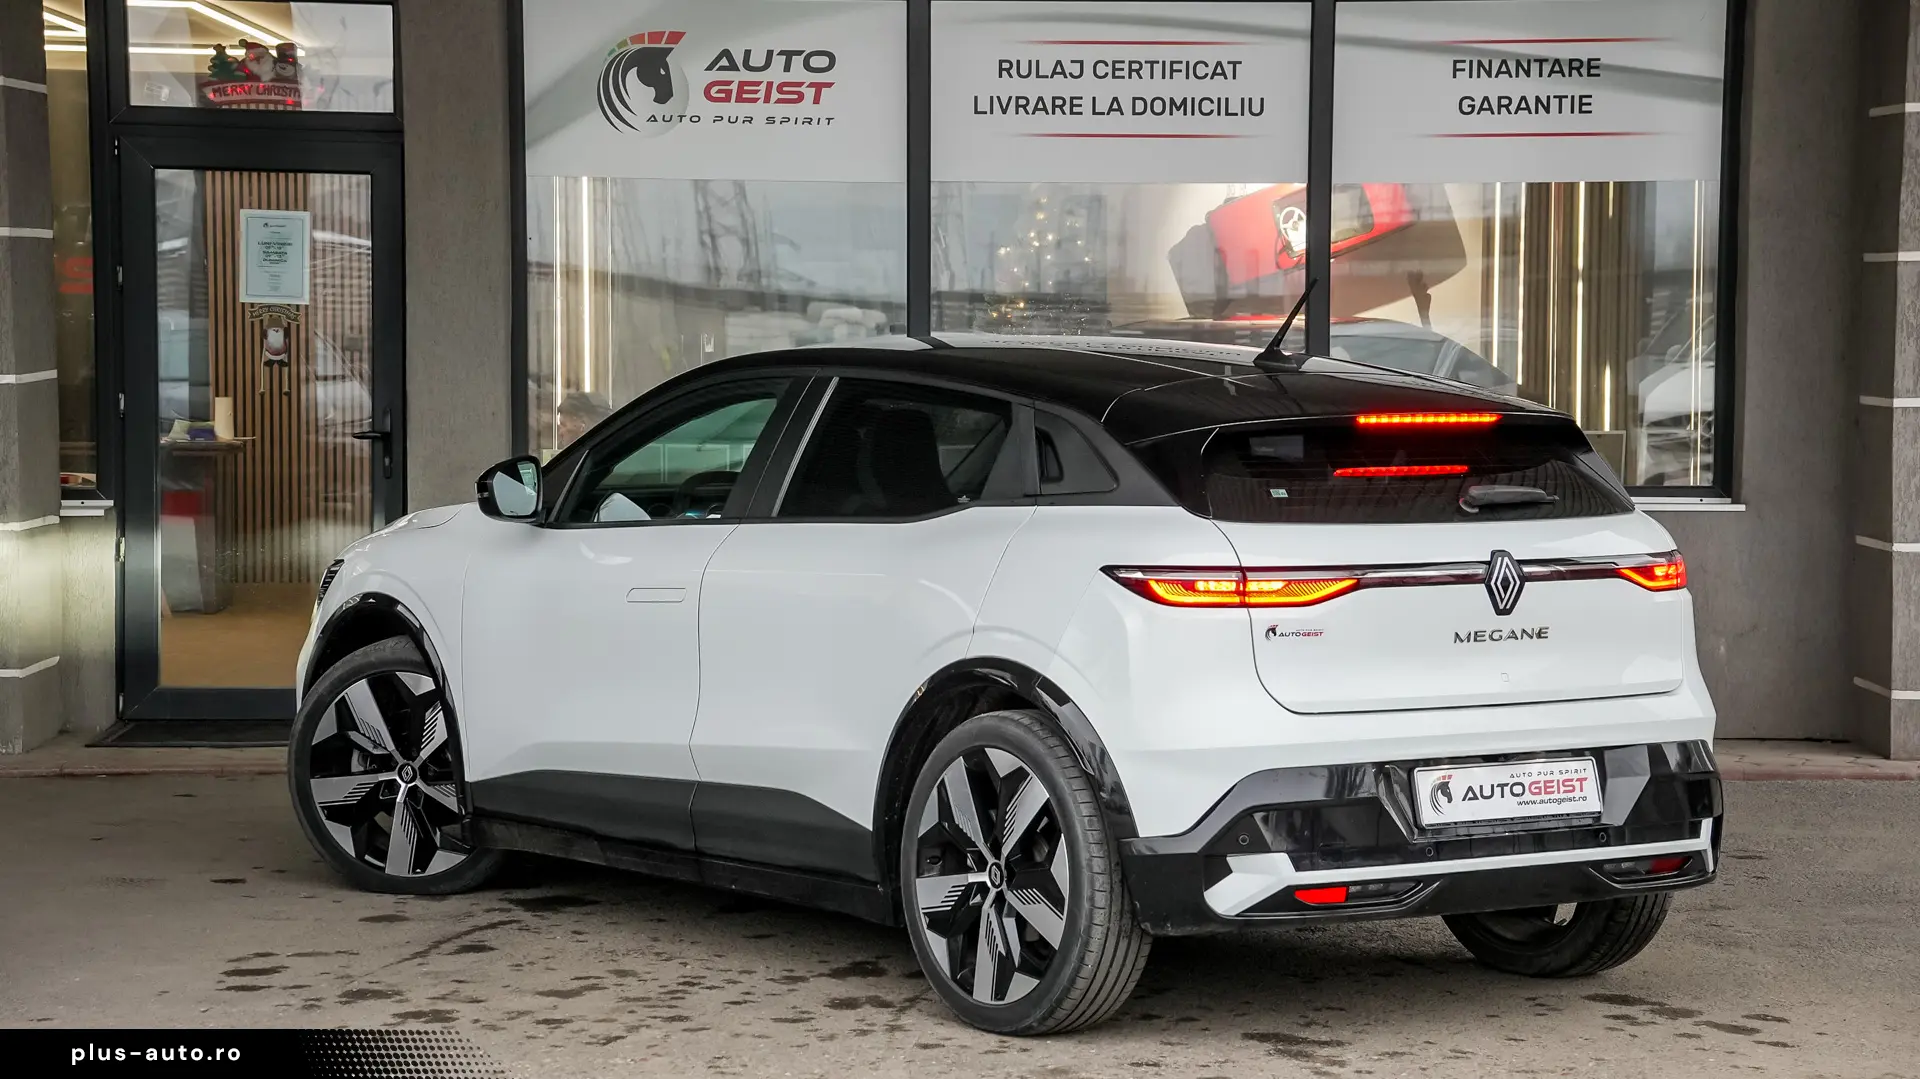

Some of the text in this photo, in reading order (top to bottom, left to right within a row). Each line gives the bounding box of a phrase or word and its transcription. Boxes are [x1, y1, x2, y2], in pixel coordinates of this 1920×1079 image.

[703, 48, 837, 74] AUTO
[998, 59, 1242, 81] RULAJ CERTIFICAT
[1452, 58, 1601, 79] FINANTARE
[212, 84, 253, 98] MERRY
[703, 80, 836, 105] GEIST
[973, 95, 1265, 117] LIVRARE LA DOMICILIU
[1458, 95, 1593, 116] GARANTIE
[646, 114, 836, 126] AUTO PUR SPIRIT
[1453, 626, 1550, 644] MEGANE
[1558, 768, 1588, 776] SPIRIT
[1461, 777, 1588, 802] AUTOGEIST
[1516, 795, 1588, 807] www.autogeist.ro
